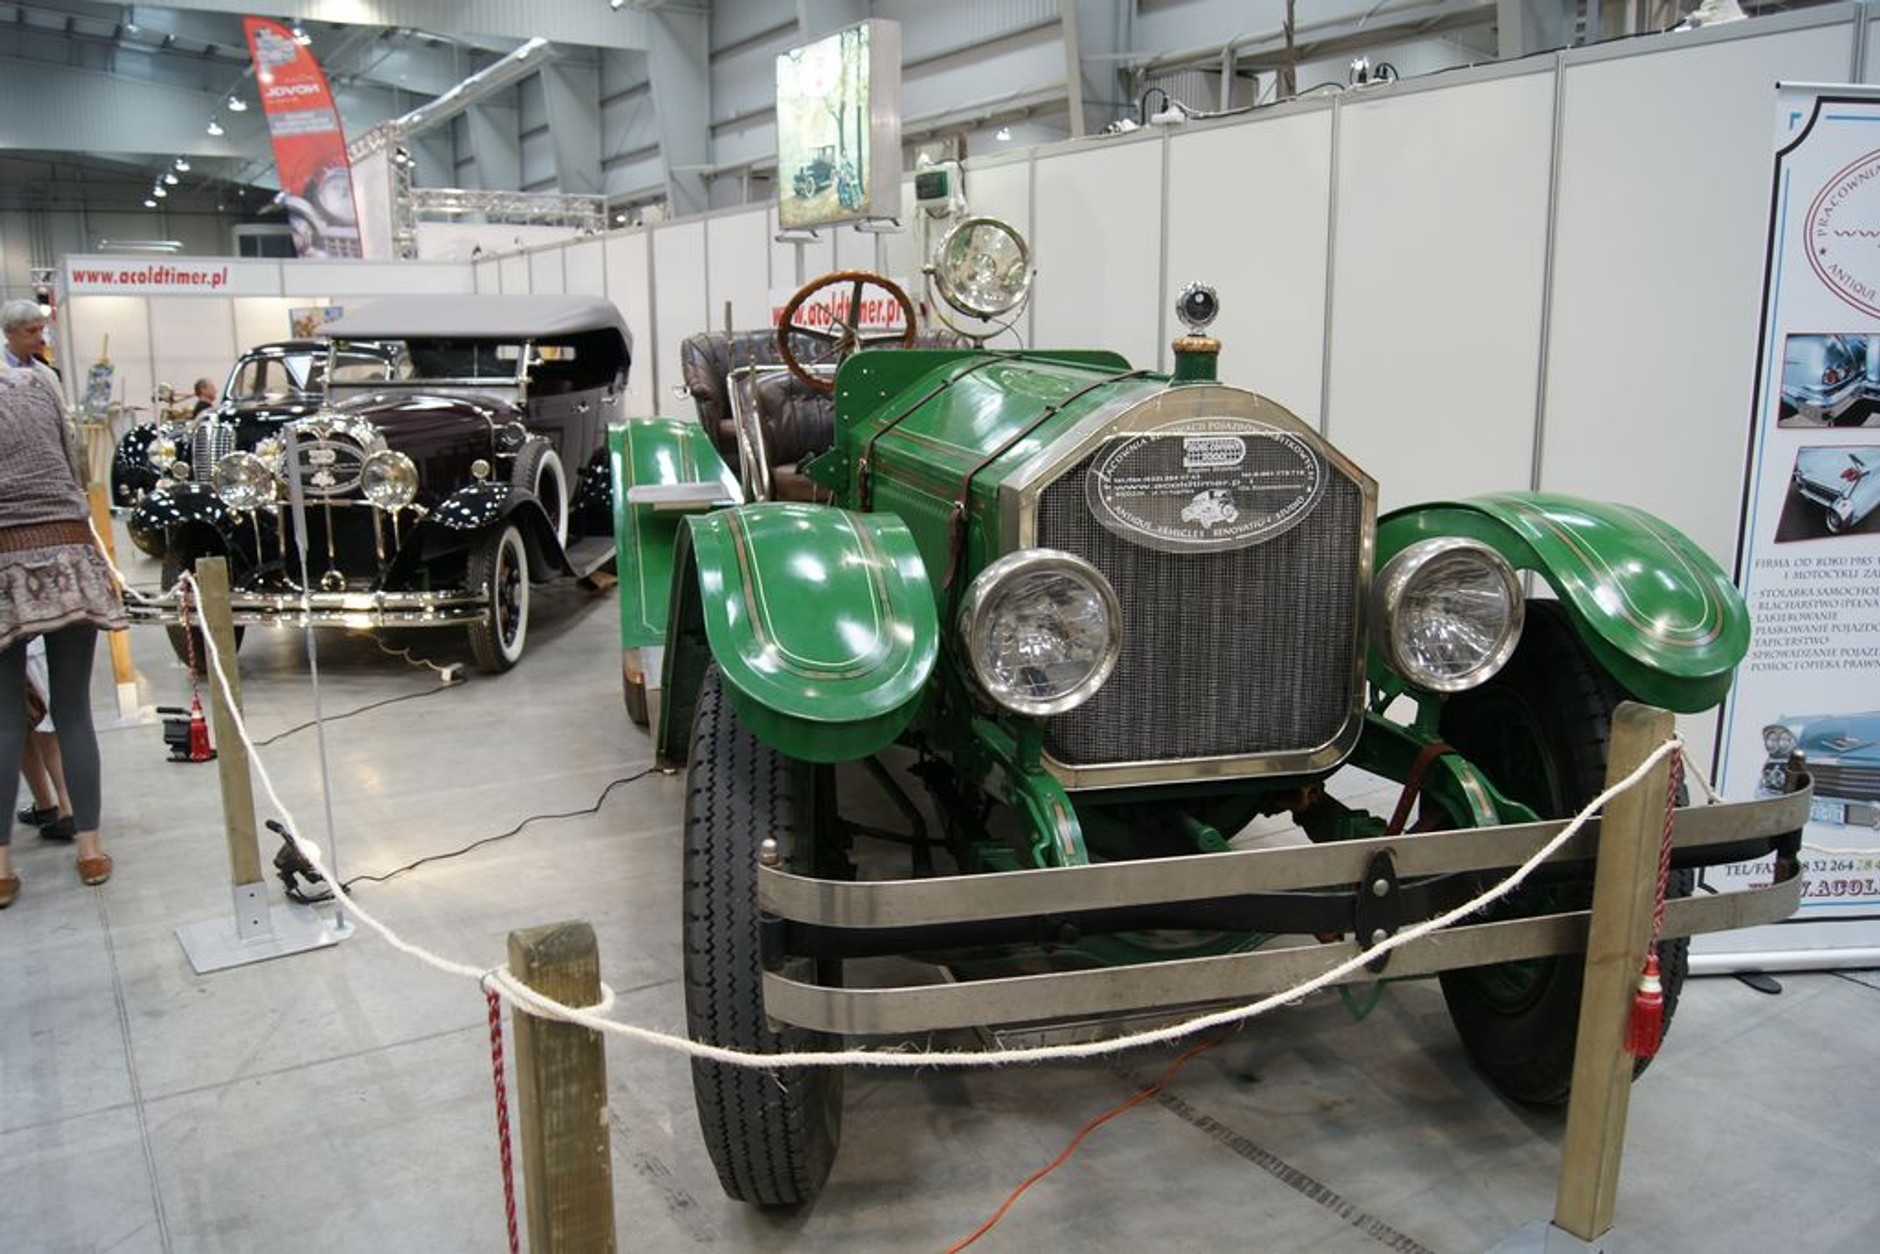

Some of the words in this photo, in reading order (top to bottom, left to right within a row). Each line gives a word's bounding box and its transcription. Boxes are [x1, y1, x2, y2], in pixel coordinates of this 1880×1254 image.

[72, 265, 228, 289] www.acoldtimer.pl
[1828, 263, 1877, 301] ANTIQUE
[772, 291, 900, 329] ww.acoldtmer.pl
[1112, 506, 1151, 529] ANTIQUE
[1793, 557, 1812, 567] OD
[1759, 586, 1814, 598] STOLARKA
[1759, 598, 1838, 611] BLACHARSTWO
[1756, 611, 1838, 624] LAKIEROWANIE
[1754, 622, 1828, 635] PIASKOWANIE
[1754, 635, 1830, 648] TAPICERSTWO
[1752, 646, 1837, 661] SPROWADZANIE
[1751, 661, 1792, 673] POMOC
[1812, 860, 1827, 872] 32
